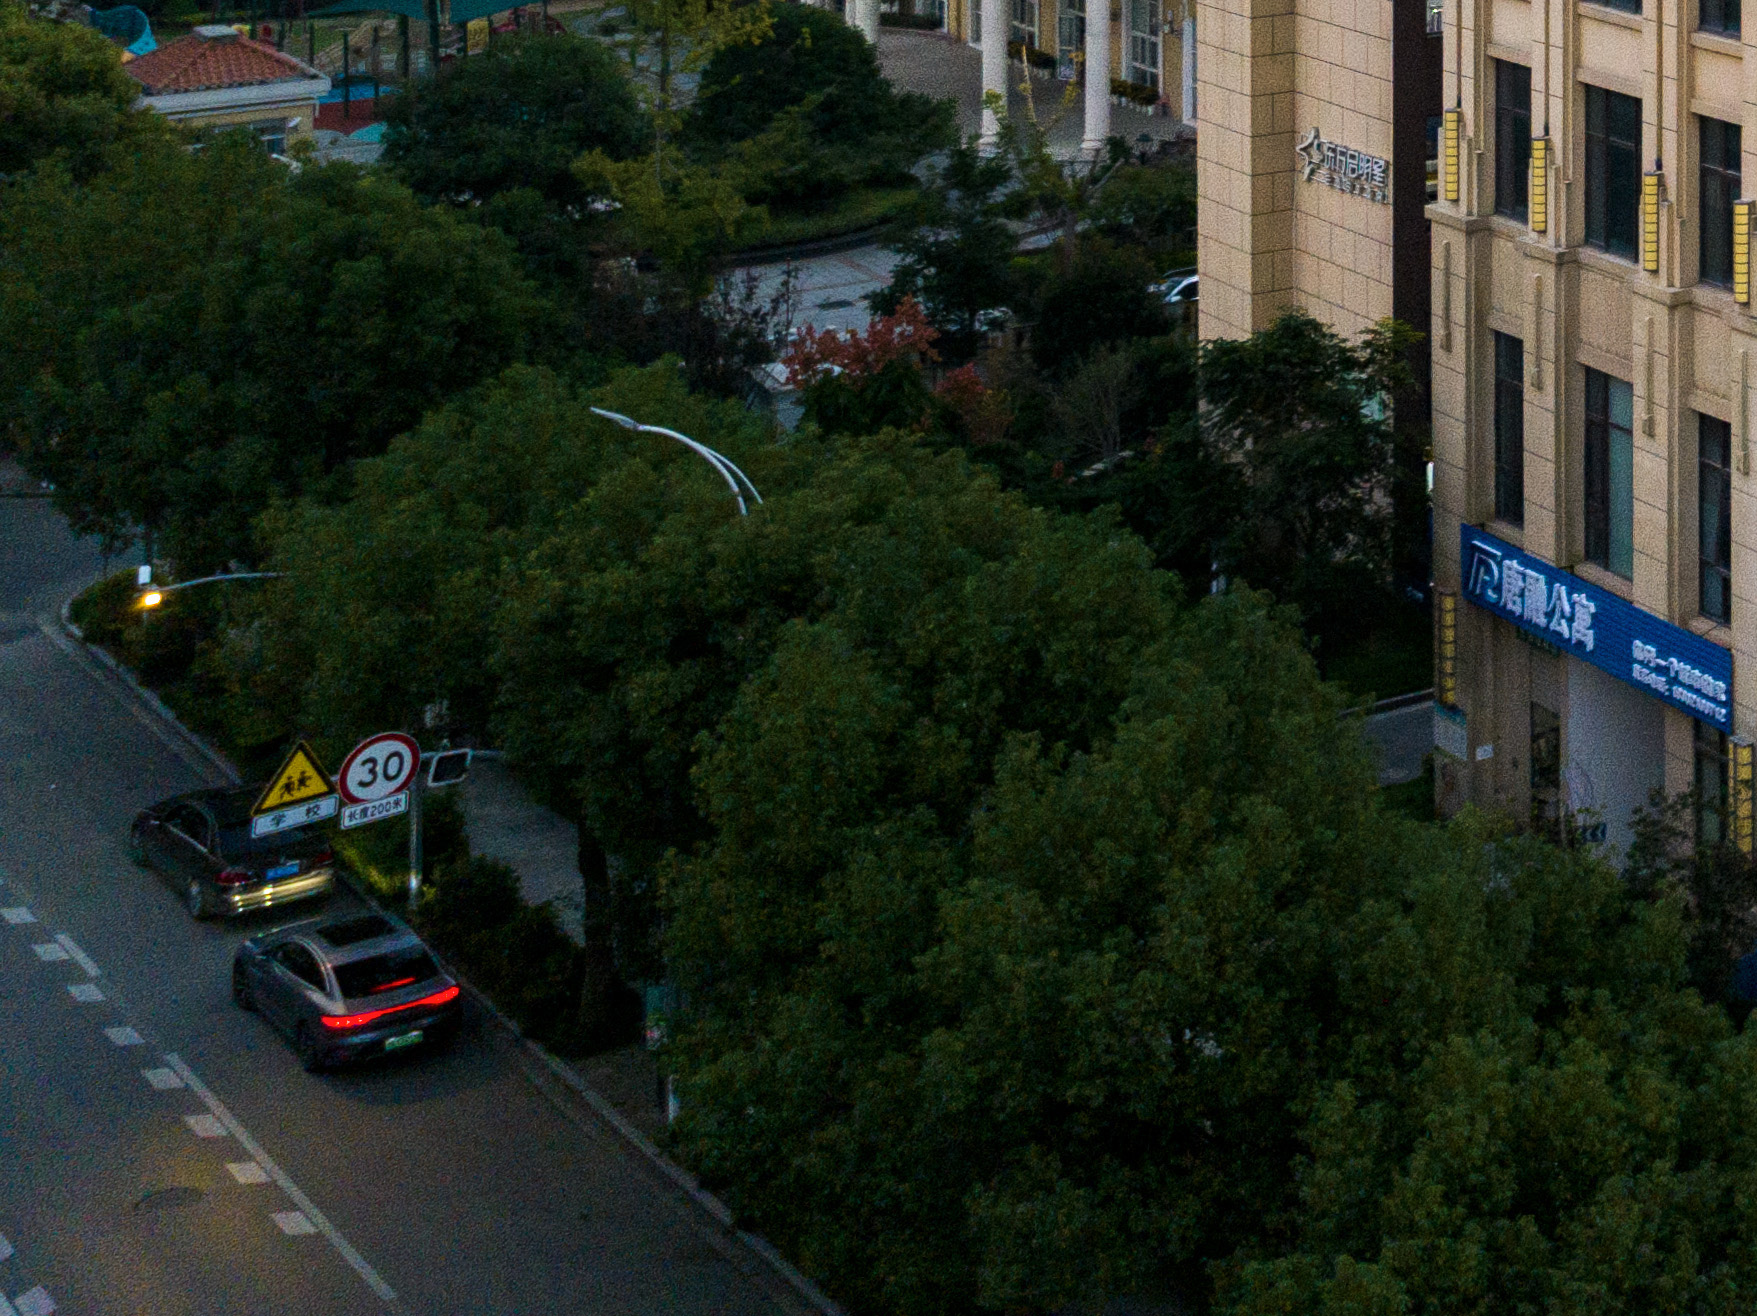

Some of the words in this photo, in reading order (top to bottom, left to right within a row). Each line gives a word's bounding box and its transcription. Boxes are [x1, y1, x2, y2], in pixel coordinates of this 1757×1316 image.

[357, 750, 405, 788] 30
[271, 803, 321, 827] 学校
[348, 797, 403, 822] 长度200米
